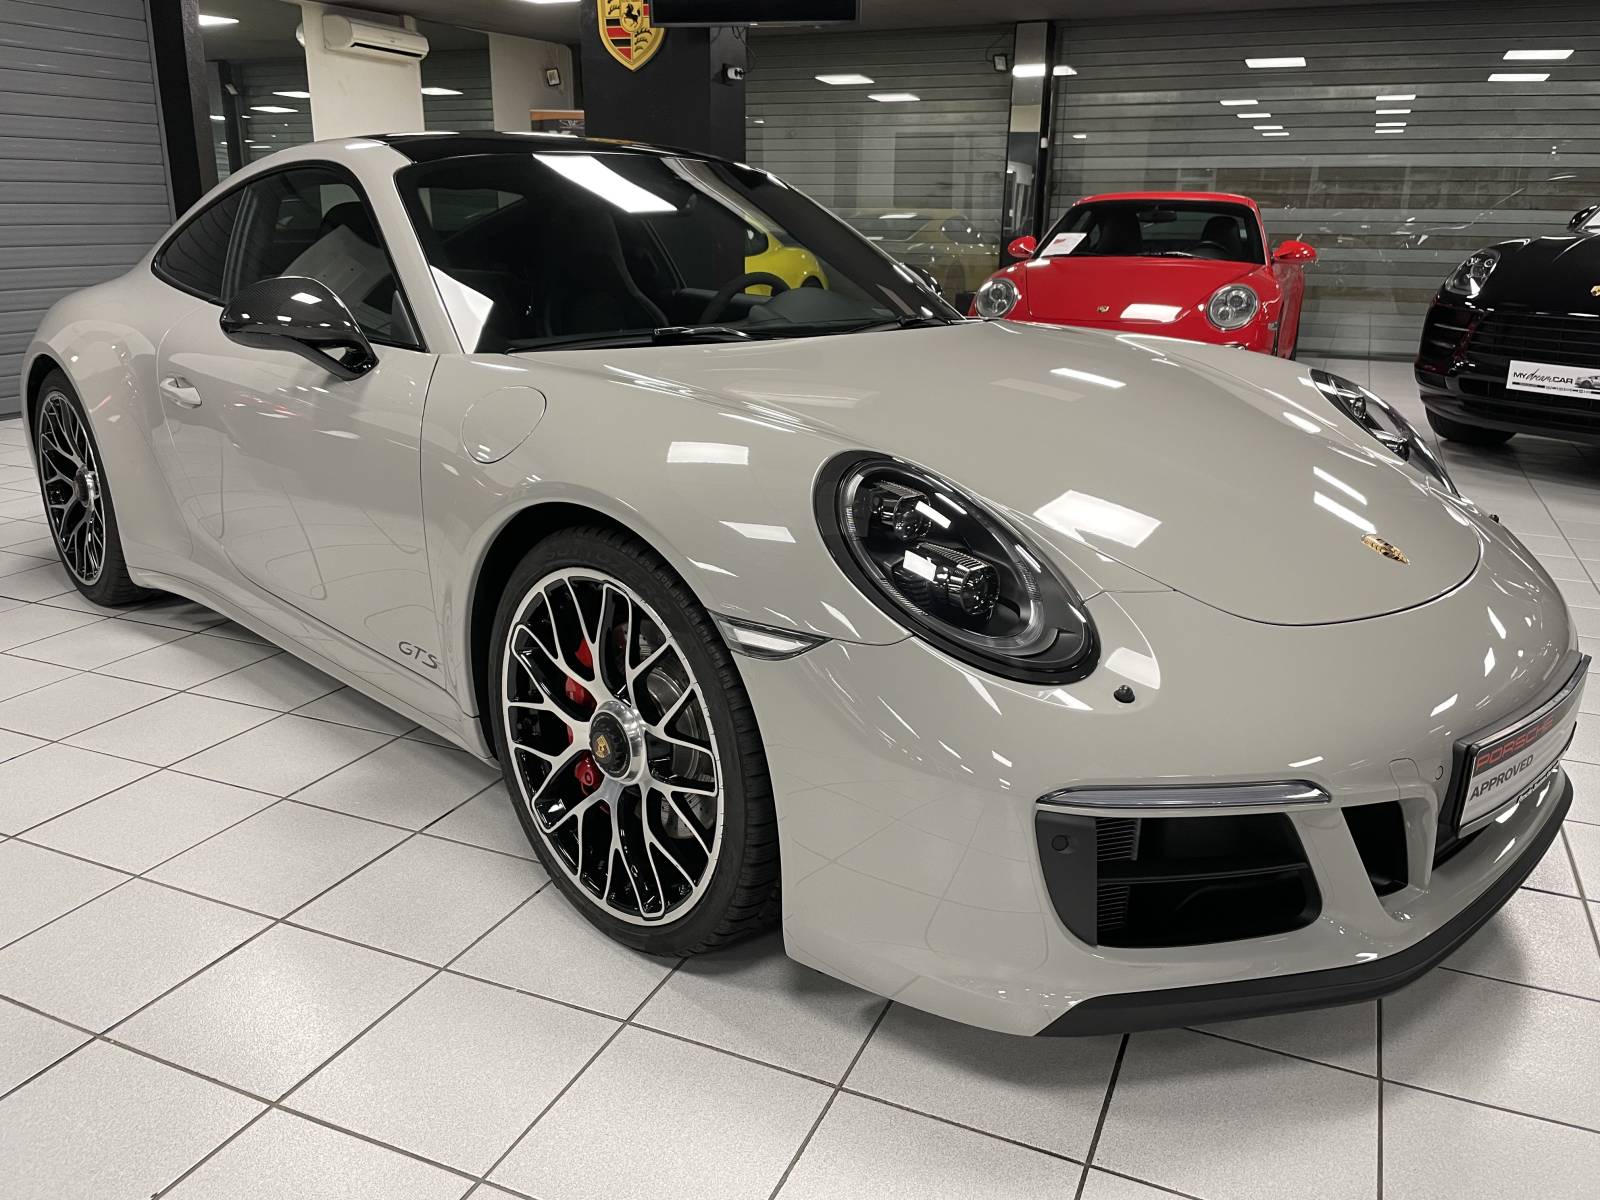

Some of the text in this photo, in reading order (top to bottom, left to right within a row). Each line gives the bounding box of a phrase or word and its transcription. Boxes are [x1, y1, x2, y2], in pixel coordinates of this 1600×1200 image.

[399, 641, 437, 669] GTS
[1476, 714, 1553, 769] PORSCHE
[1470, 755, 1534, 801] APPROVED
